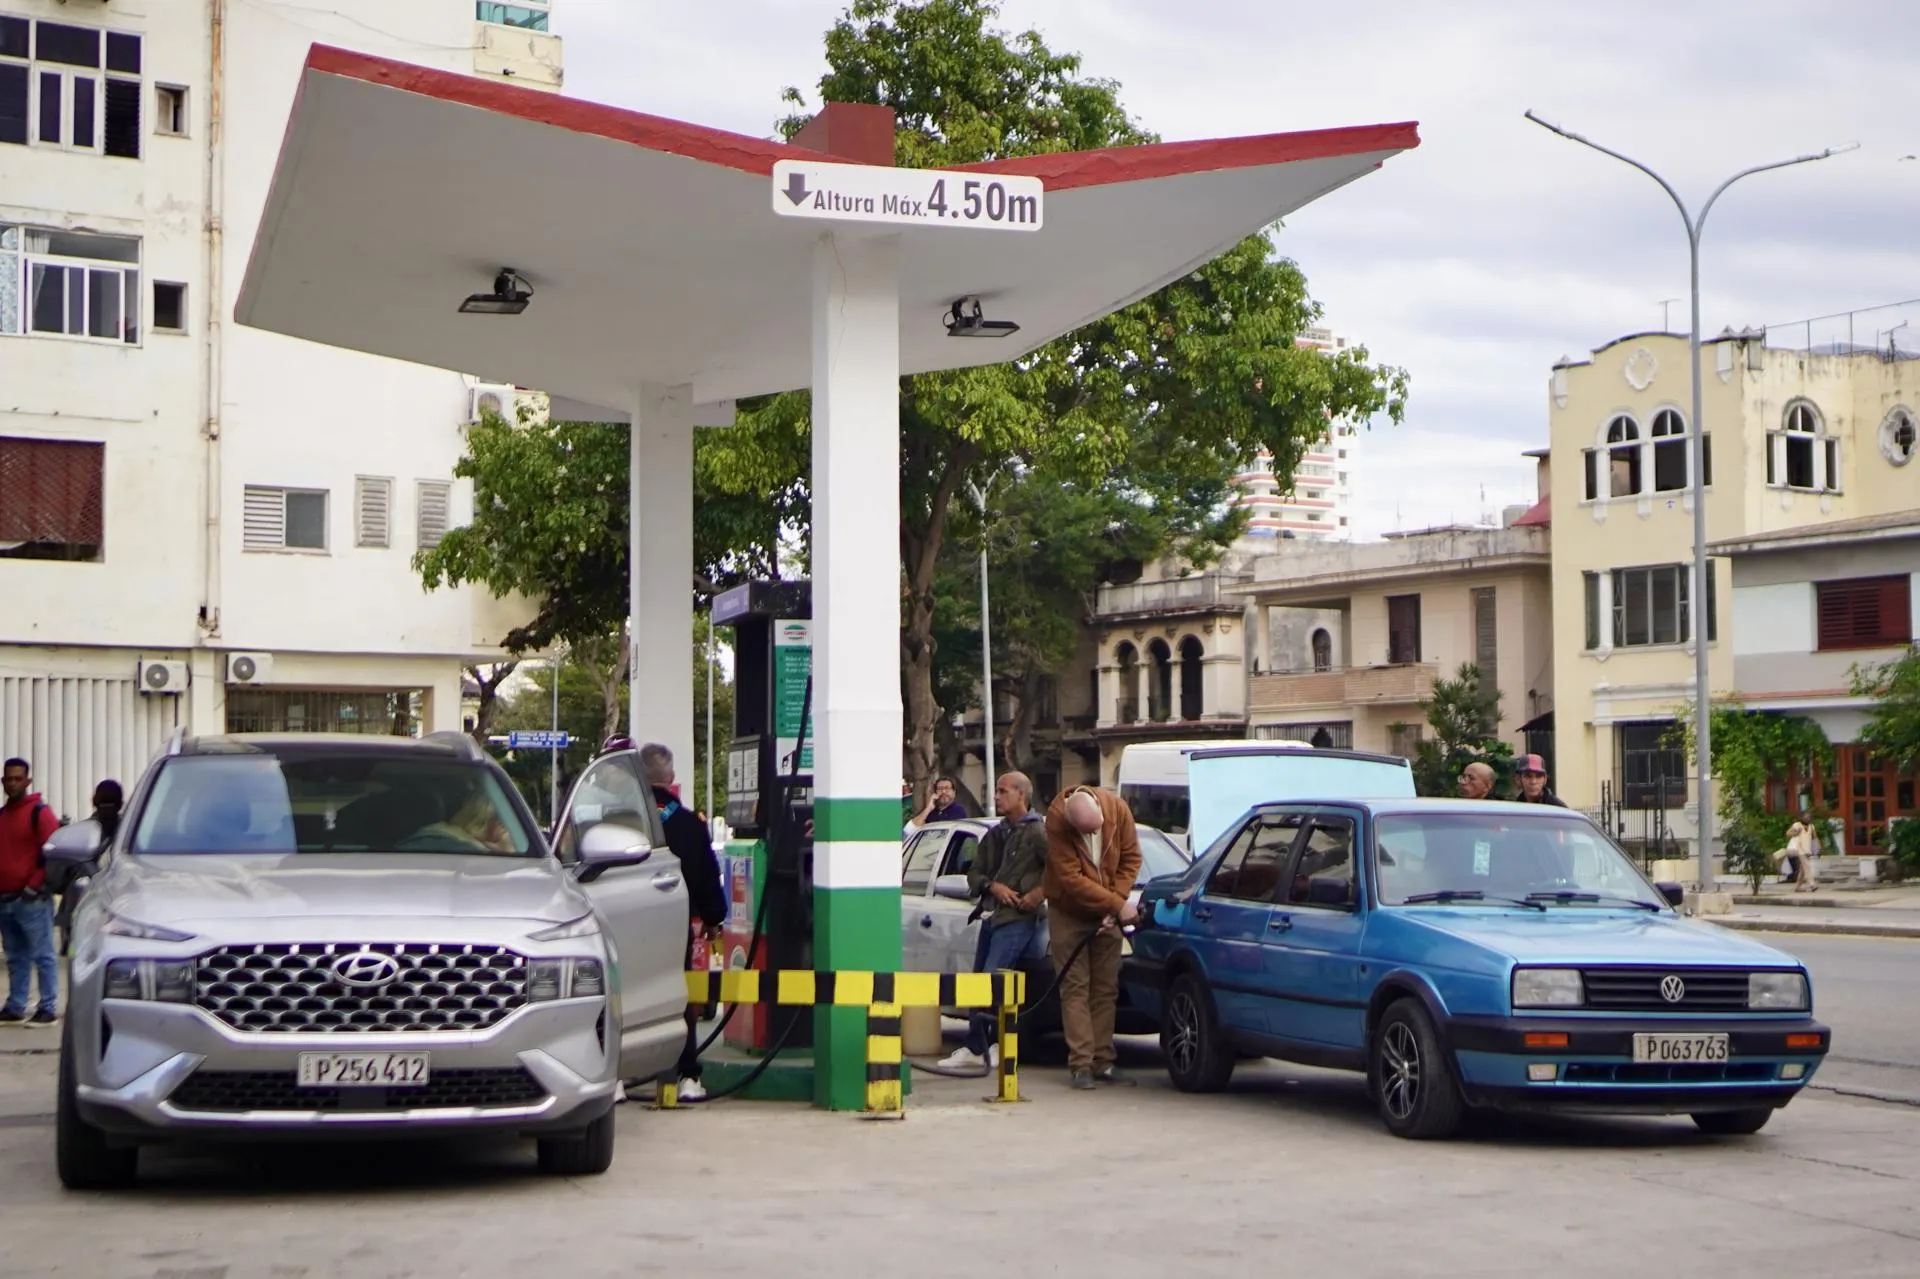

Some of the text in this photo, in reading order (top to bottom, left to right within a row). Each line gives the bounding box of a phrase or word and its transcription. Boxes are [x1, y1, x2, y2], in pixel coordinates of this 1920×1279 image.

[813, 178, 1037, 224] Altura Máx. 4.50m
